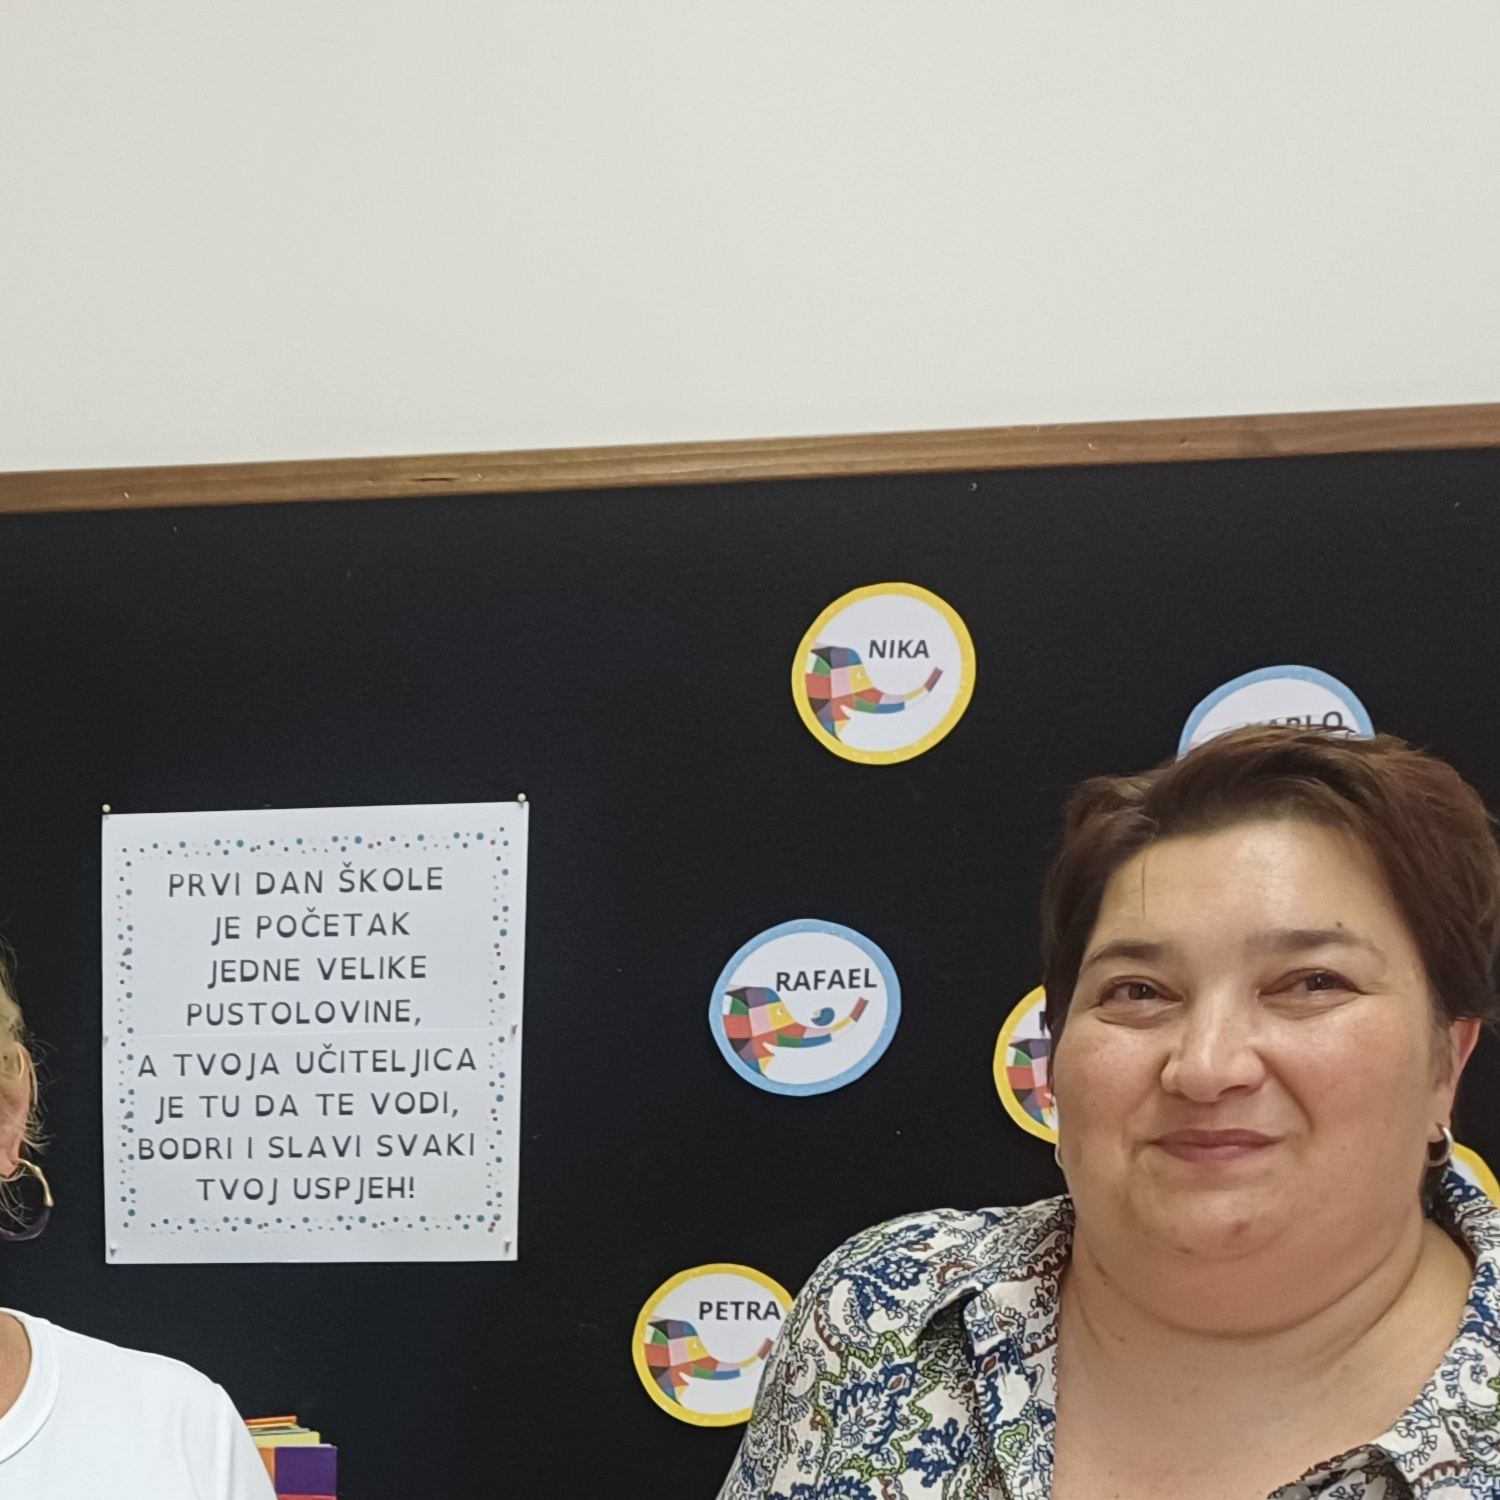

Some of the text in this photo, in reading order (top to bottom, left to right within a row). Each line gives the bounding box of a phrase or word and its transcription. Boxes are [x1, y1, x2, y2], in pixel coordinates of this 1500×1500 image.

[868, 639, 930, 659] NIKA
[168, 861, 443, 898] PRVI DAN ŠKOLE
[210, 906, 411, 947] JE POČETAK
[207, 955, 427, 990] JEDNE VELIKE
[775, 967, 878, 992] RAFAEL
[186, 998, 421, 1027] PUSTOLOVINE,
[137, 1043, 477, 1082] A TVOJA UČITELJICA
[154, 1090, 458, 1125] JE TU DA TE VODI,
[138, 1132, 475, 1161] BODRI I SLAVI SVAKI
[195, 1176, 415, 1206] TVOJ USPJEH!
[698, 1300, 781, 1320] PETRA
